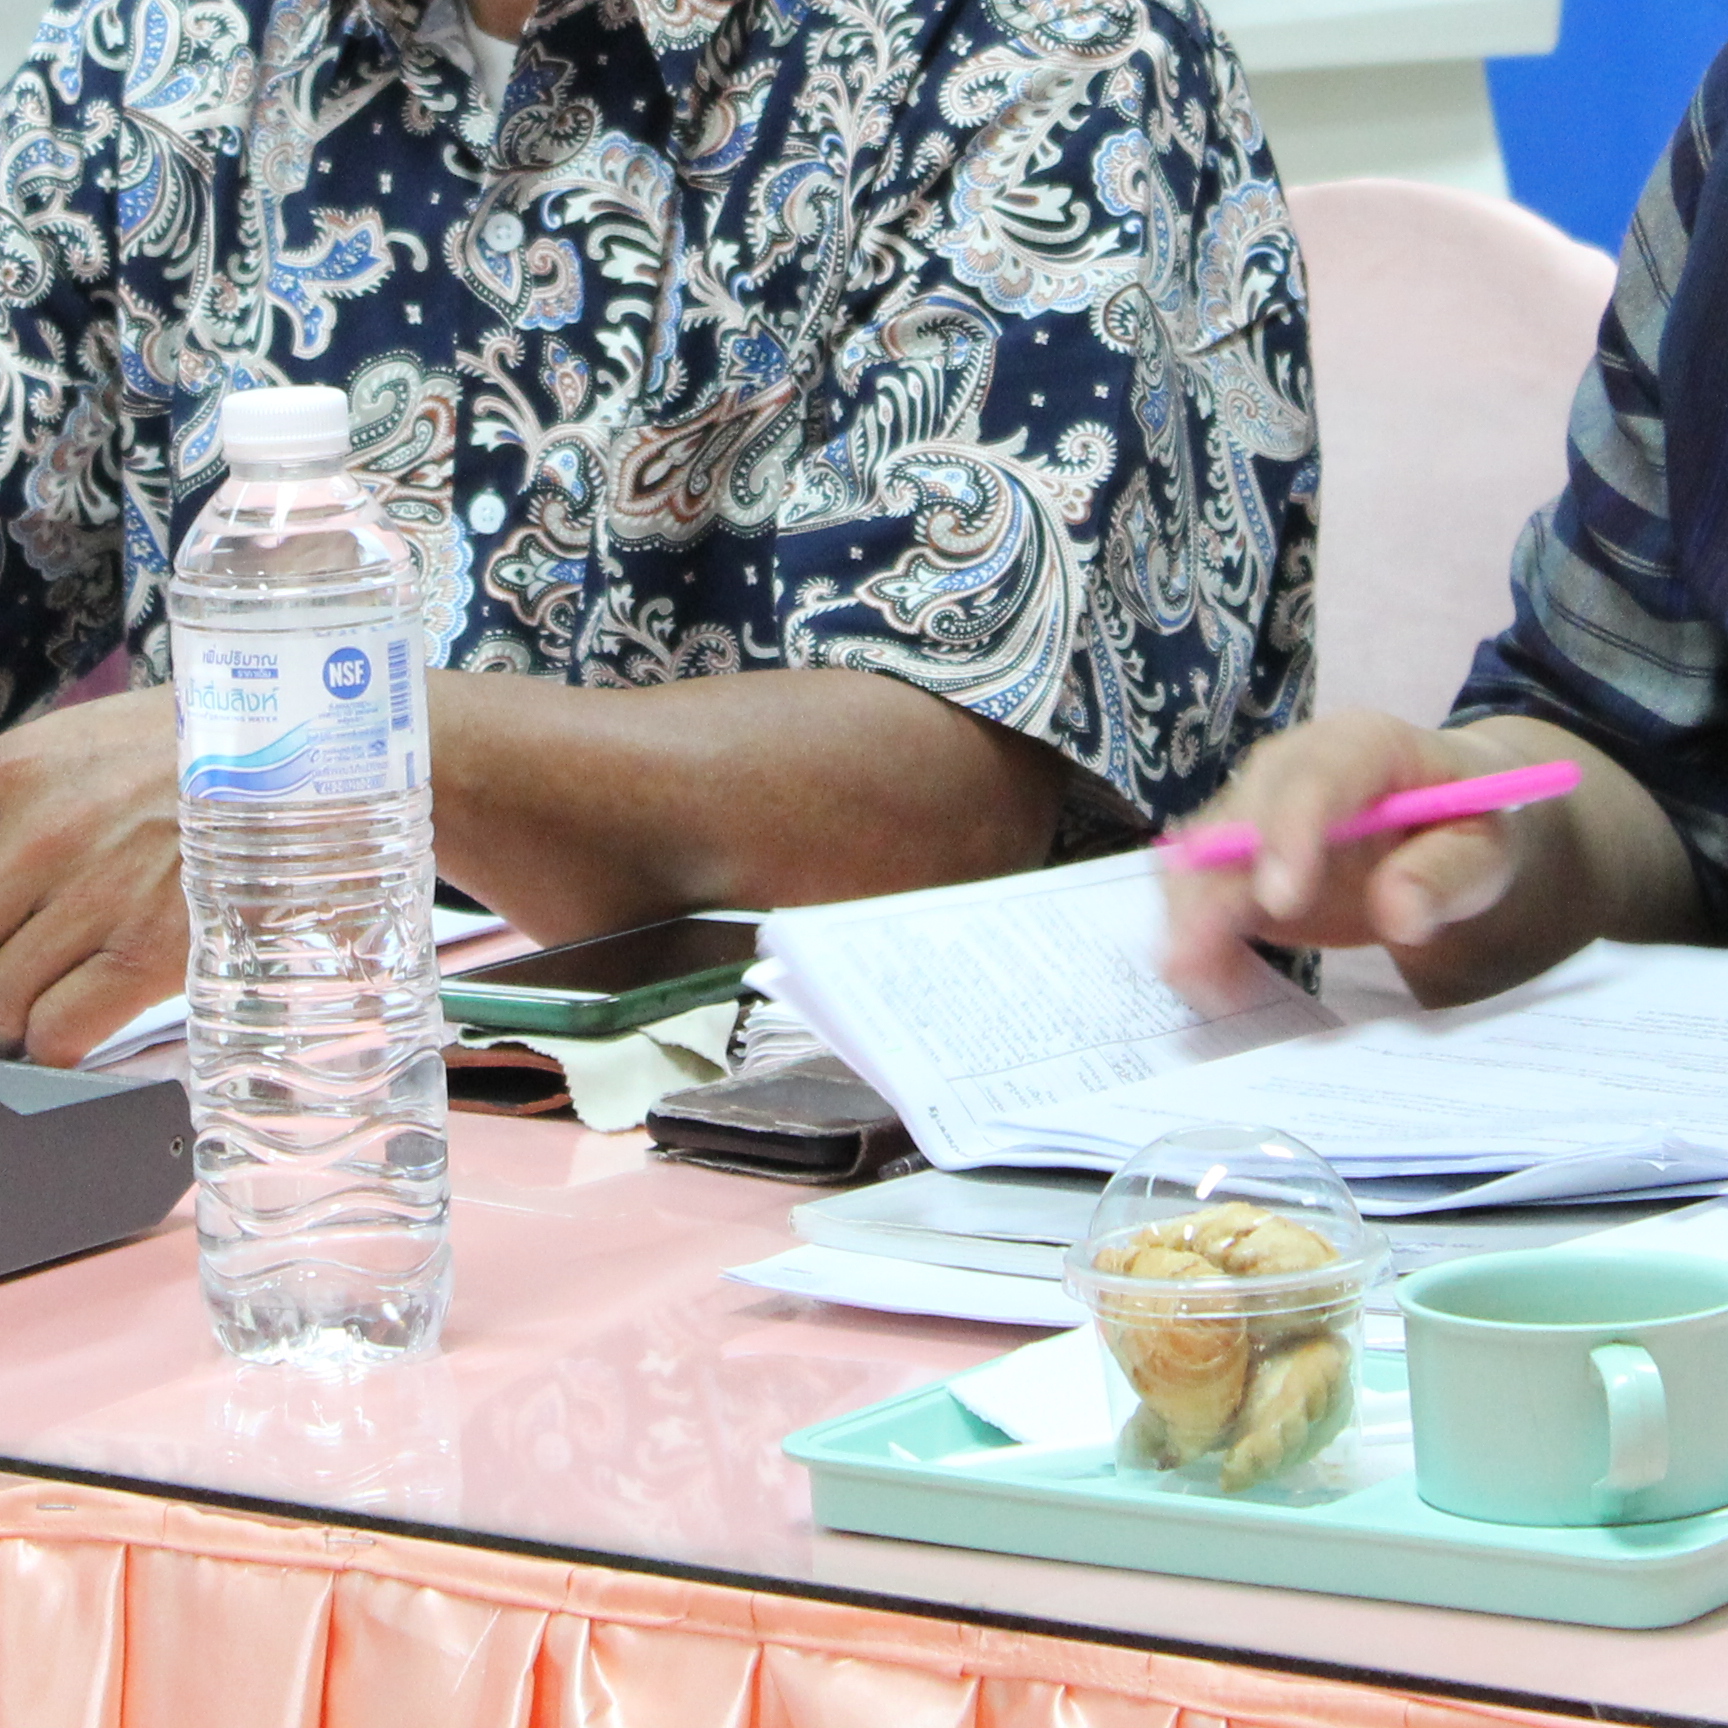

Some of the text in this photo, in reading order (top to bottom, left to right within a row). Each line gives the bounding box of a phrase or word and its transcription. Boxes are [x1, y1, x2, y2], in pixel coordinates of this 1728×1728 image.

[202, 644, 278, 668] เพิ่มปริมาณ
[329, 659, 365, 688] NSF
[185, 676, 280, 713] น้ำดื่มสิงห์
